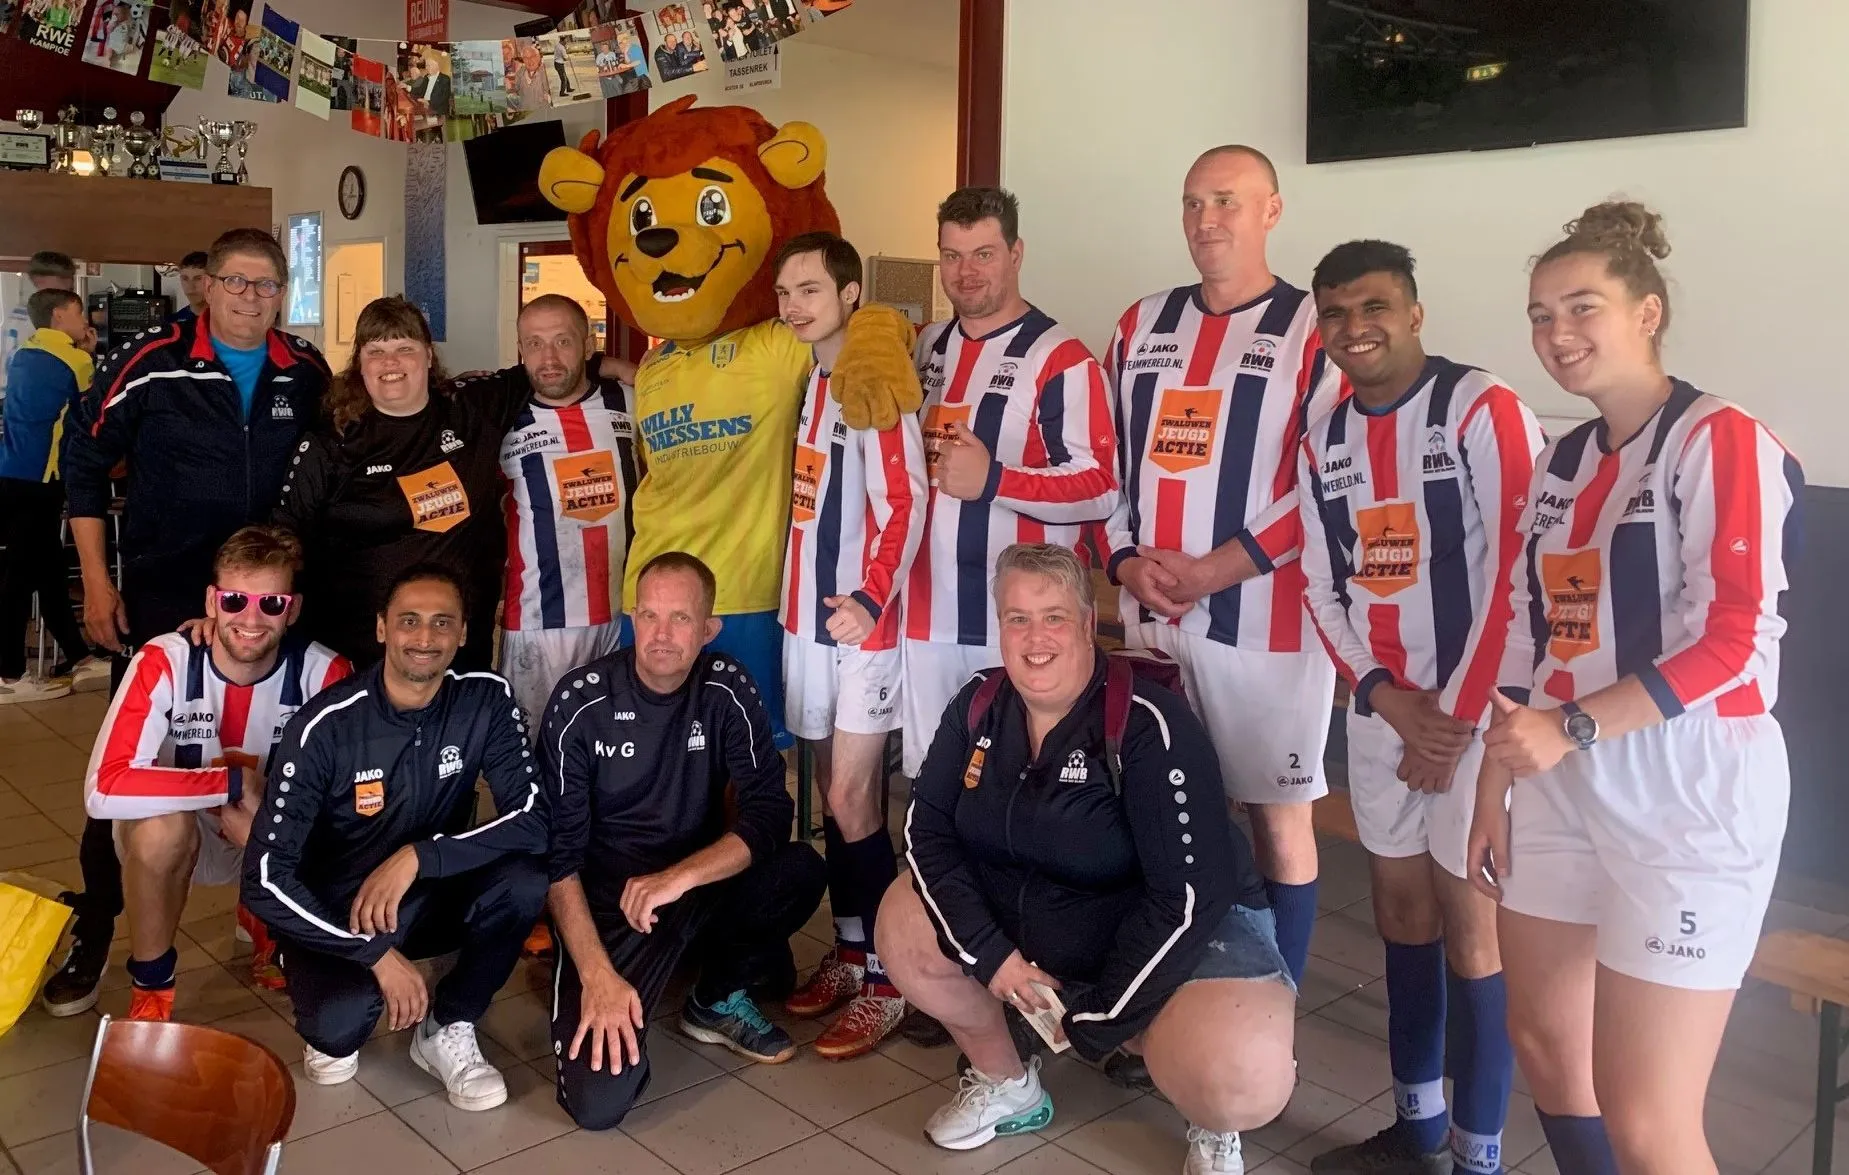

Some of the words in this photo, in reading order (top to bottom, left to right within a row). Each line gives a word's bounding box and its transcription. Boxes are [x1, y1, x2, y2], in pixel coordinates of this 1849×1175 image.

[36, 24, 75, 48] RWE
[729, 63, 768, 78] TASSENREK
[1150, 343, 1179, 354] JAKO
[1123, 357, 1183, 371] TEAMWERELD.NL
[1240, 352, 1275, 369] RWB
[990, 374, 1015, 387] RWB
[611, 421, 632, 431] RWB
[1160, 419, 1212, 429] ZWALUWEN
[522, 429, 548, 442] JAKO
[1158, 427, 1210, 441] JEUGD
[503, 436, 561, 461] TEAMWERELD.NL
[1153, 440, 1208, 457] ACTIE
[366, 464, 393, 475] JAKO
[1324, 456, 1352, 474] JAKO
[563, 475, 613, 489] ZWALUWEN
[1322, 471, 1367, 494] WERELD.NL
[412, 483, 458, 503] ZWALUWEN
[565, 482, 615, 499] JEUGD
[416, 490, 463, 515] JEUGD
[566, 493, 616, 511] ACTIE
[418, 501, 466, 524] ACTIE
[879, 686, 888, 701] 6
[1288, 752, 1301, 769] 2
[354, 768, 384, 783] JAKO
[1060, 766, 1088, 780] RWB
[1290, 775, 1314, 786] JAKO
[1679, 910, 1697, 935] 5
[1666, 944, 1706, 960] JAKO
